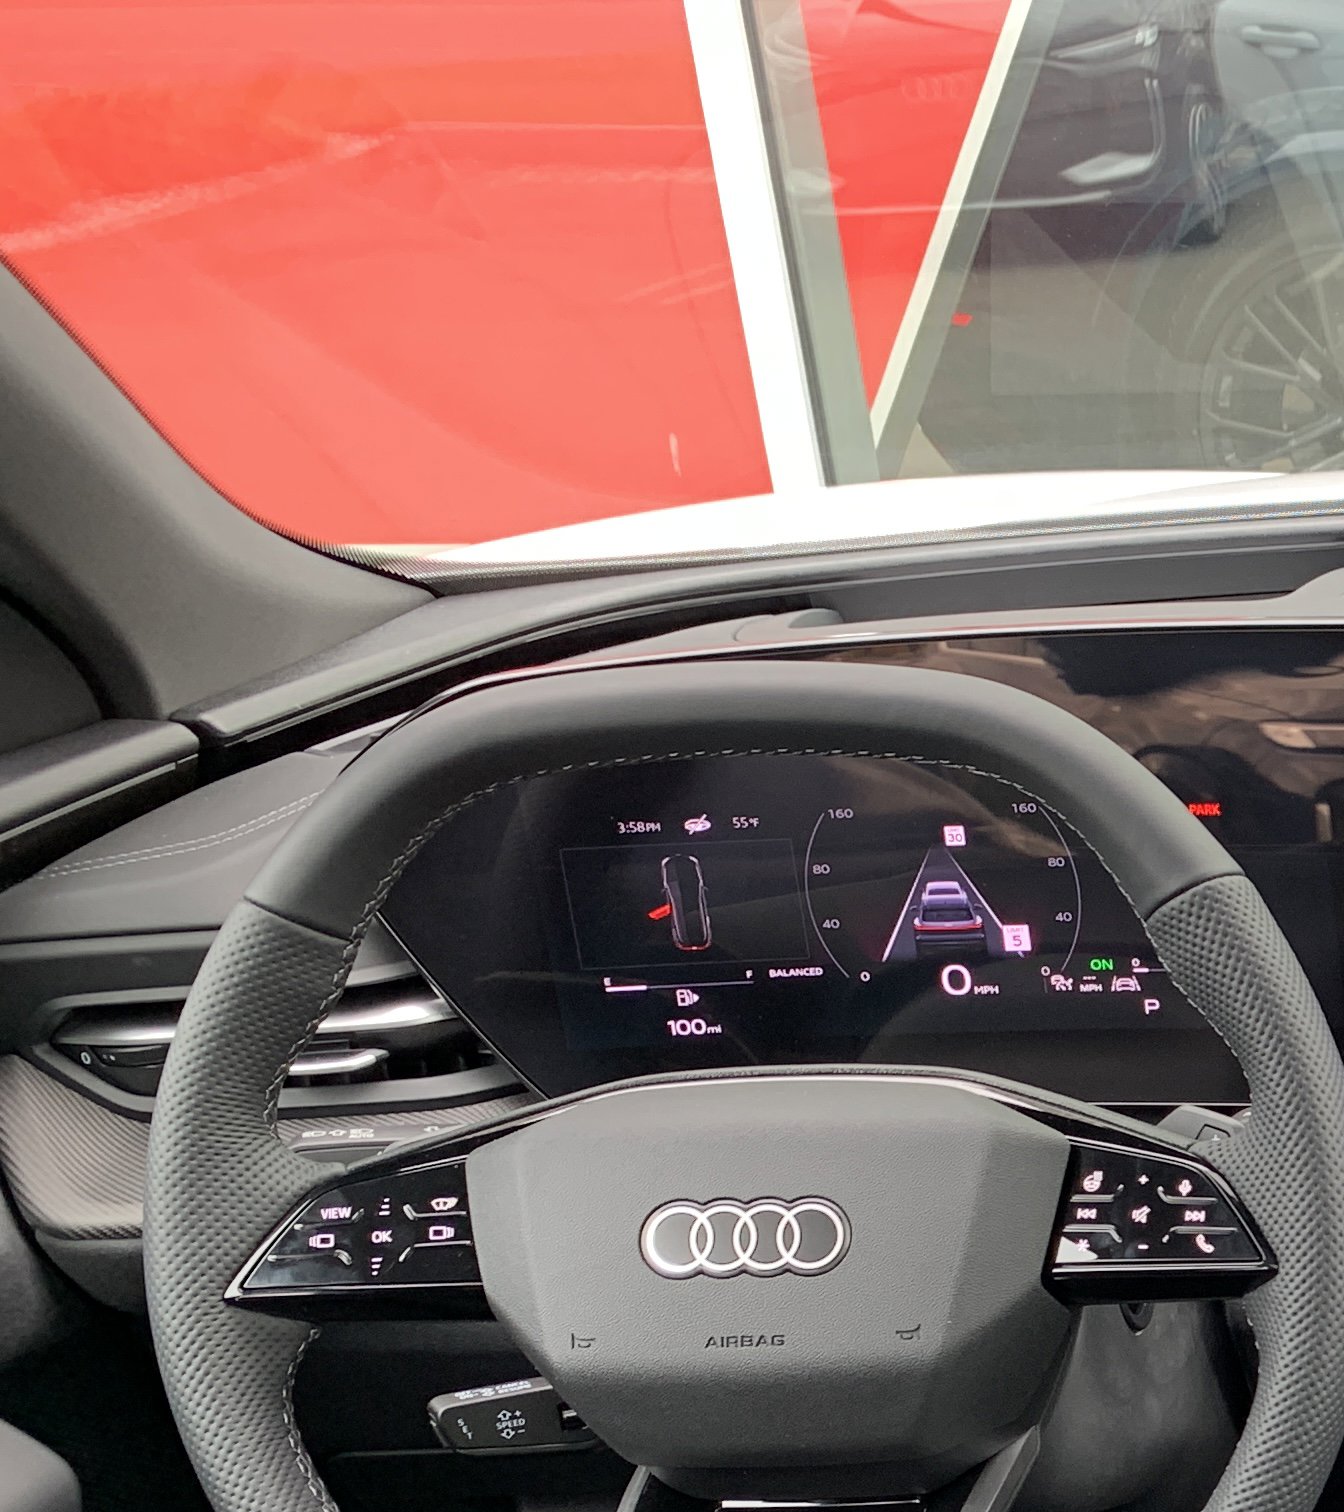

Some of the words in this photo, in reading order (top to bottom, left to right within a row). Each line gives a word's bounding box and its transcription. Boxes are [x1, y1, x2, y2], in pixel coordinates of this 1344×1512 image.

[828, 808, 854, 819] 160
[1011, 802, 1037, 814] 160
[1188, 803, 1222, 817] PARK
[948, 833, 963, 843] 30
[1047, 857, 1065, 868] 80
[812, 864, 831, 875] 80
[1055, 911, 1072, 923] 40
[822, 918, 840, 929] 40
[1012, 935, 1023, 947] 5
[1090, 958, 1114, 971] ON
[768, 967, 824, 978] BALANCED
[860, 971, 871, 982] 0
[1041, 966, 1050, 977] 0
[603, 977, 611, 986] E
[940, 964, 972, 996] 0
[974, 984, 999, 995] MPH
[1079, 982, 1103, 993] MPH
[1144, 999, 1160, 1015] P
[320, 1206, 353, 1220] VIEW
[371, 1230, 393, 1245] OK
[704, 1333, 786, 1349] AIRBAG
[457, 1418, 474, 1440] SET
[495, 1418, 526, 1430] SPEED
